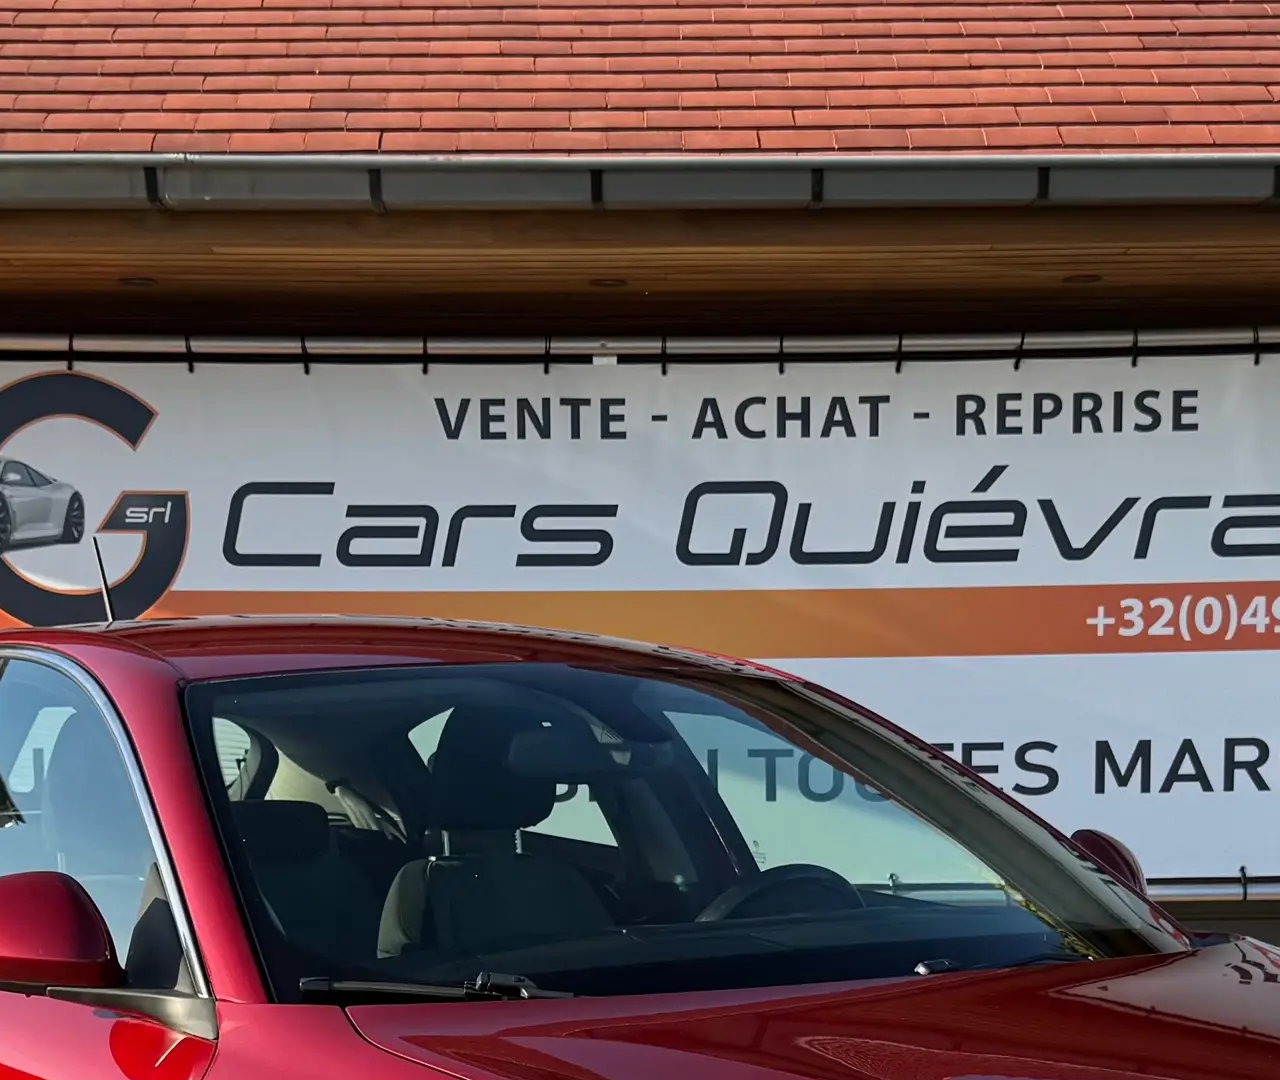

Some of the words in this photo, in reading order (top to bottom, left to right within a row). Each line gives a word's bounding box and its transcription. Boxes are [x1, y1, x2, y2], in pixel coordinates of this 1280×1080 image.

[433, 397, 627, 440] VENTE
[691, 394, 891, 439] ACHAT
[955, 389, 1199, 436] REPRISE
[124, 501, 172, 524] srl
[222, 482, 619, 568] Cars
